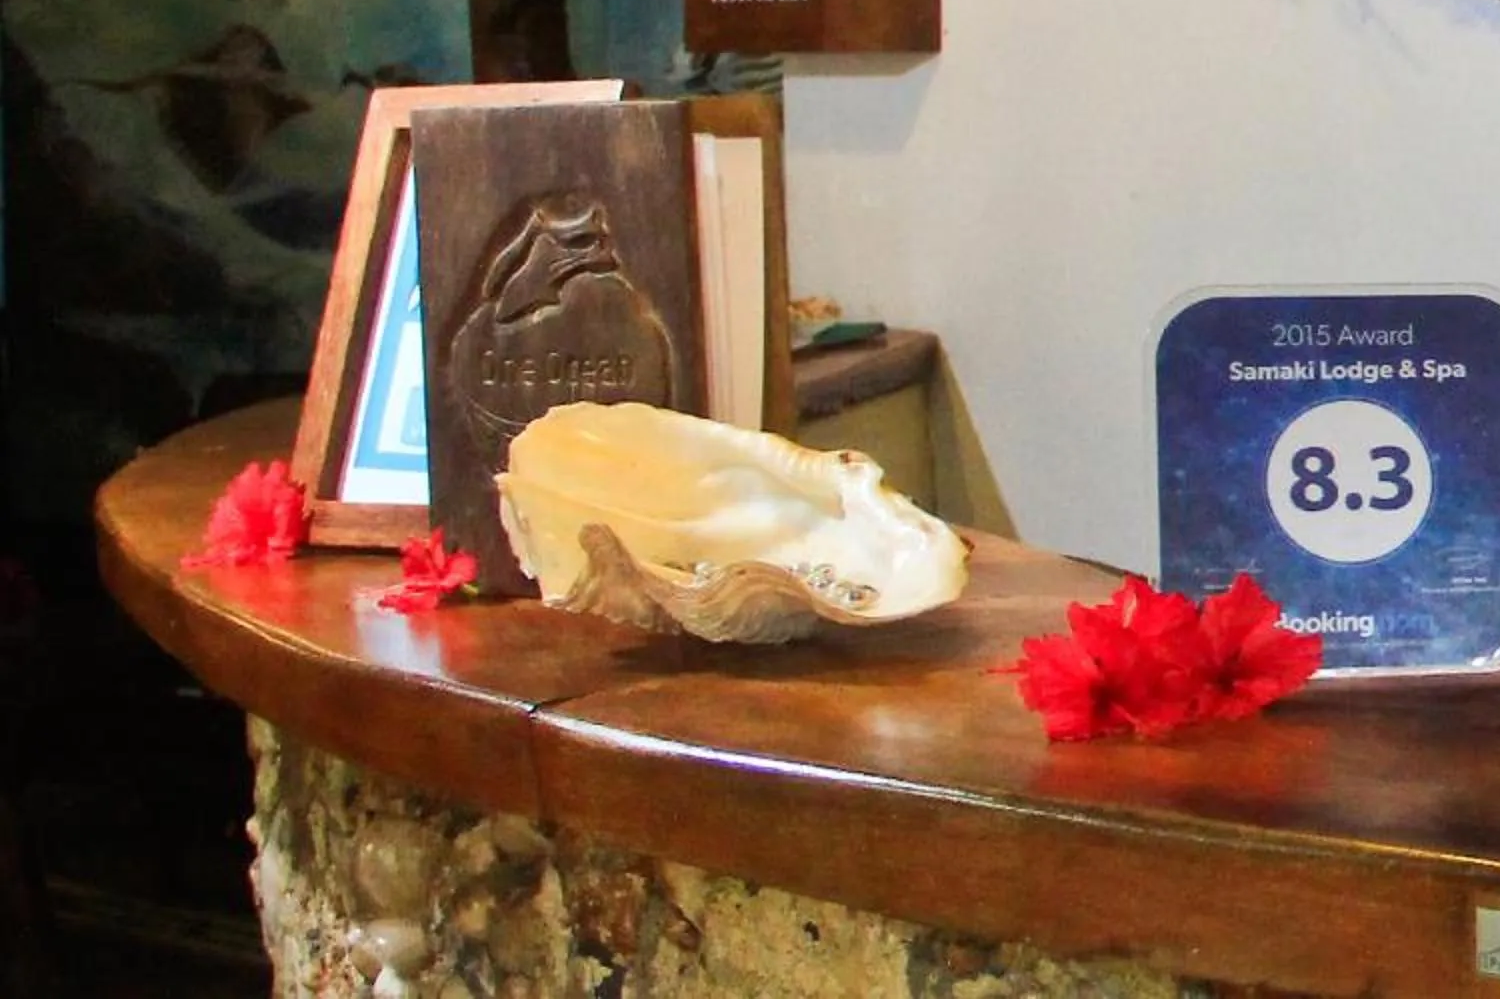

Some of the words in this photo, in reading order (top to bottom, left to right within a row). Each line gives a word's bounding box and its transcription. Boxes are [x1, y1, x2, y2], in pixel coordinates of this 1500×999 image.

[1271, 323, 1332, 347] 2015
[1336, 323, 1414, 346] Award
[1228, 360, 1316, 382] Samaki
[1319, 360, 1394, 384] Lodge
[1398, 359, 1417, 379] &
[1422, 359, 1468, 383] Spa
[1289, 445, 1414, 512] 8.3
